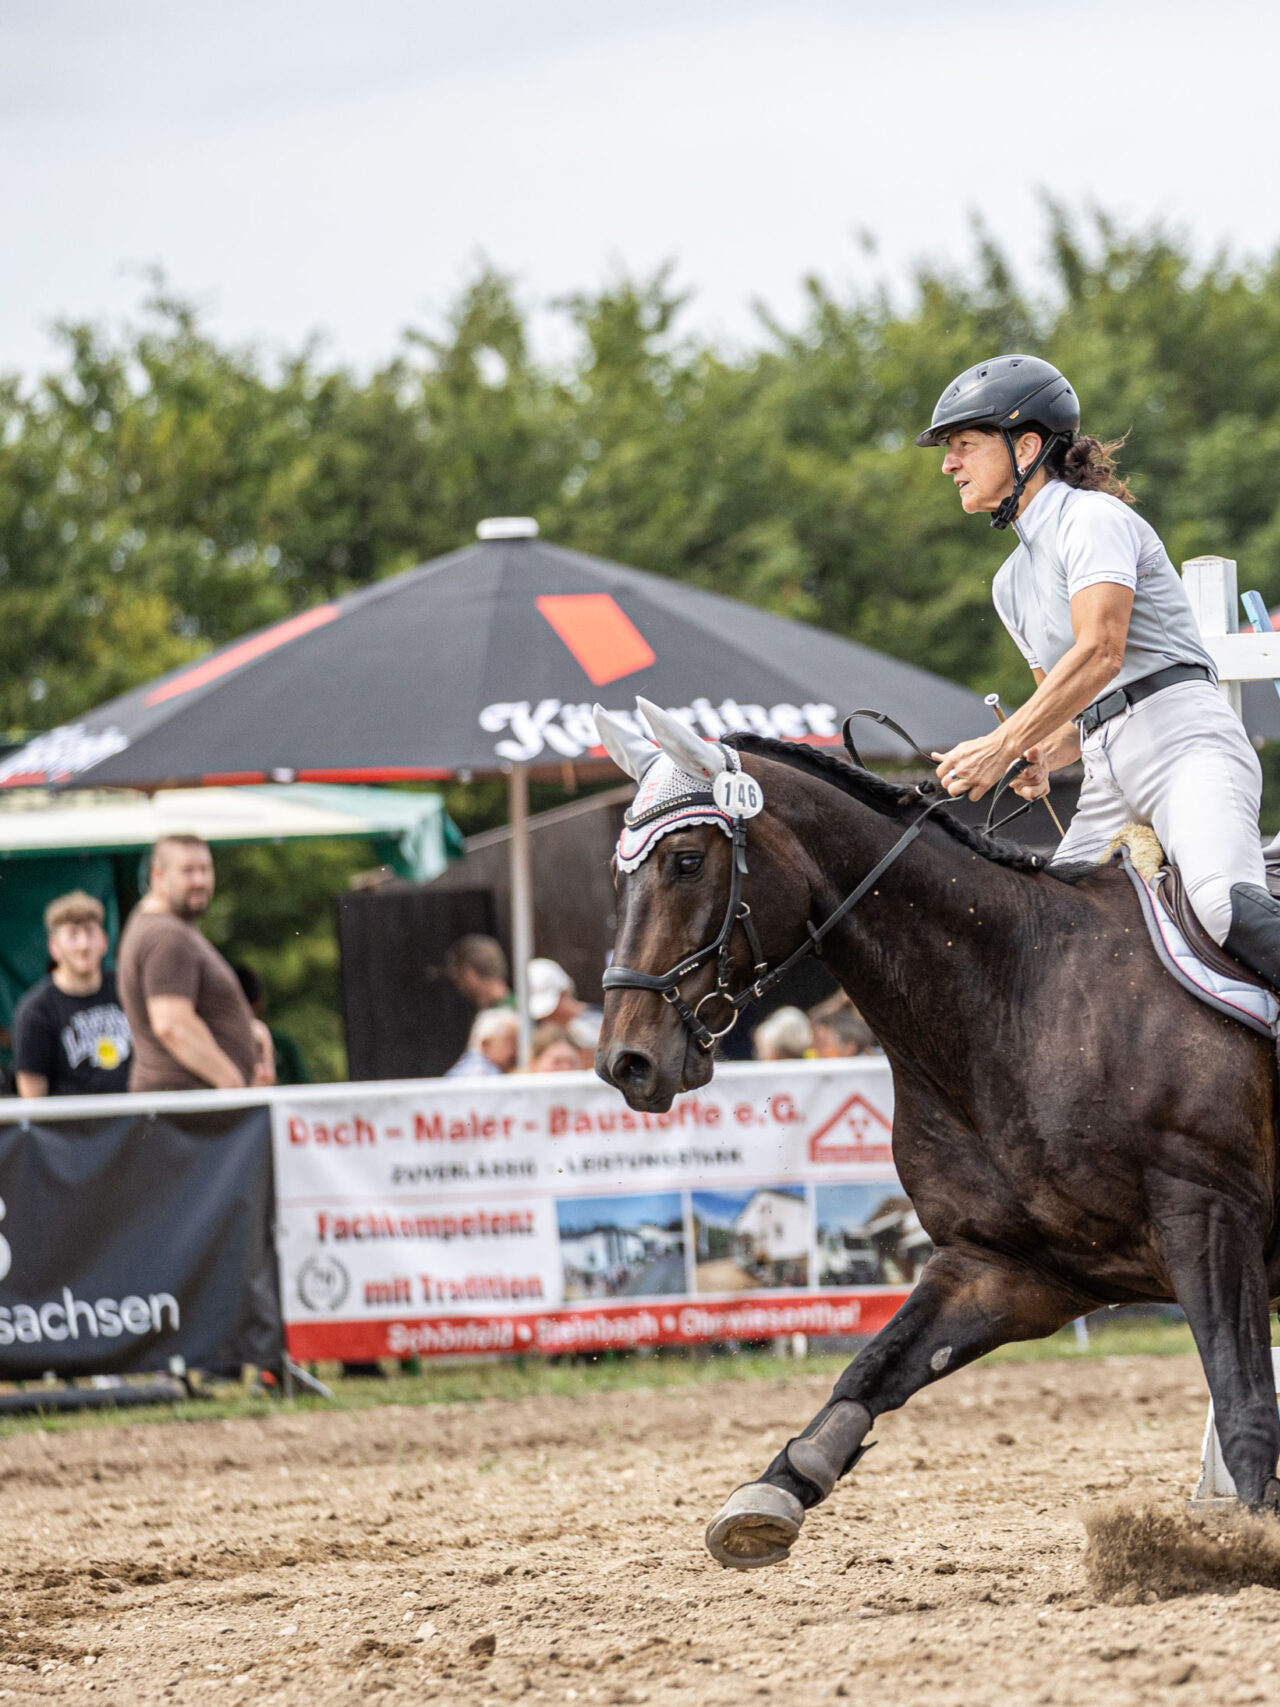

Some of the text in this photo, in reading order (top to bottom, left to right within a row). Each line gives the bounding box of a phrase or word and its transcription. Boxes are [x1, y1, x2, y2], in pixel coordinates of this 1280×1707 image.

[724, 781, 757, 808] 146
[286, 1114, 377, 1147] Dach
[413, 1110, 514, 1143] Maler
[549, 1098, 721, 1136] Baustoffe
[317, 1210, 534, 1244] Fachkompetenz
[364, 1273, 543, 1306] mit Tradition
